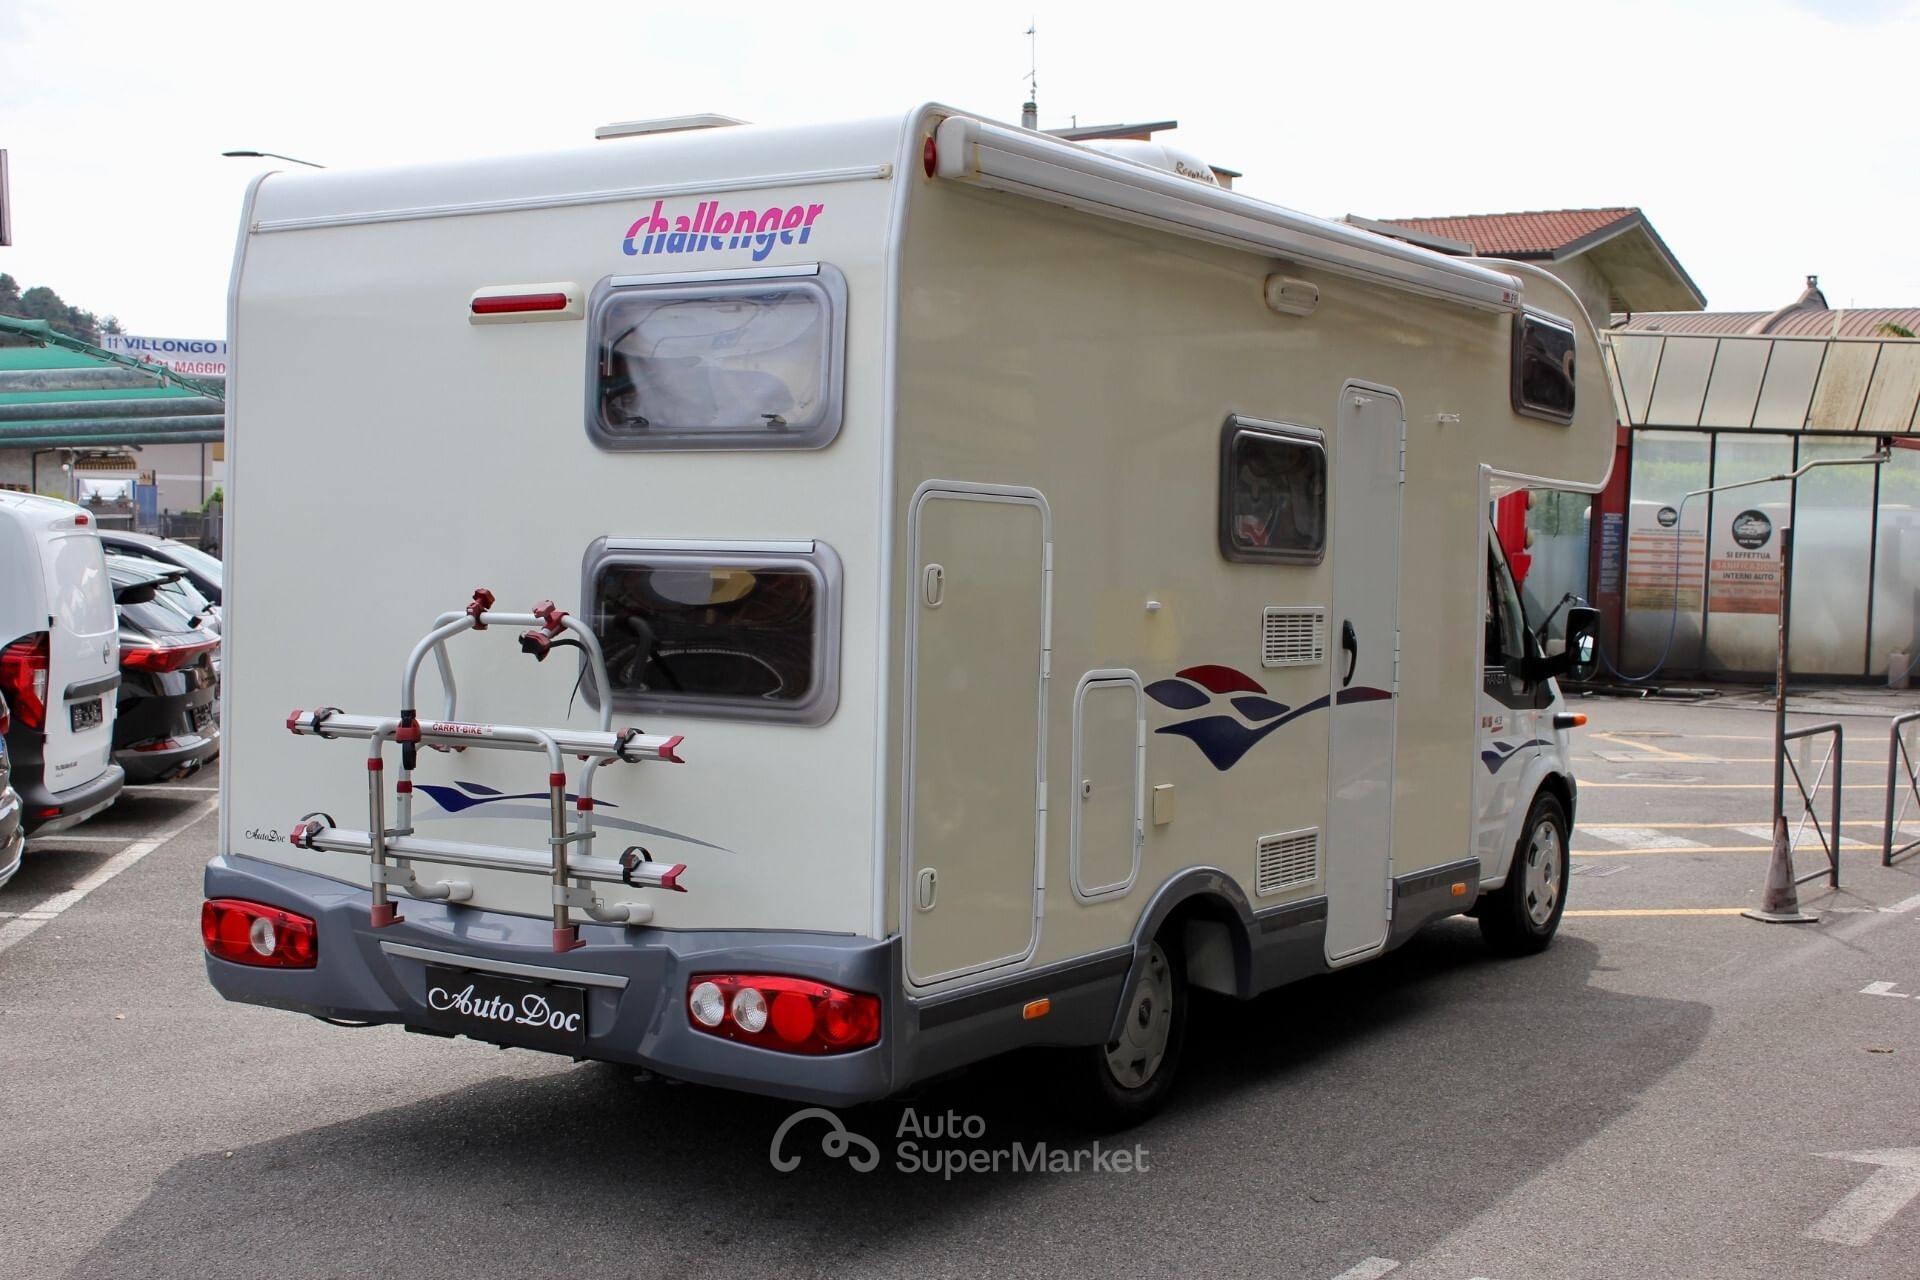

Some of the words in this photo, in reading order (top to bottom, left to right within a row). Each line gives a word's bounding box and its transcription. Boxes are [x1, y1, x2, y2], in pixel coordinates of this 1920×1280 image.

[622, 200, 825, 262] challenger
[124, 338, 217, 354] VILLONGO
[174, 361, 226, 374] MAGGIO
[1735, 551, 1771, 559] EFFETTUA
[1723, 572, 1752, 580] INTERNI
[1753, 573, 1775, 581] AUTO
[432, 723, 483, 735] CARRY-BIKE
